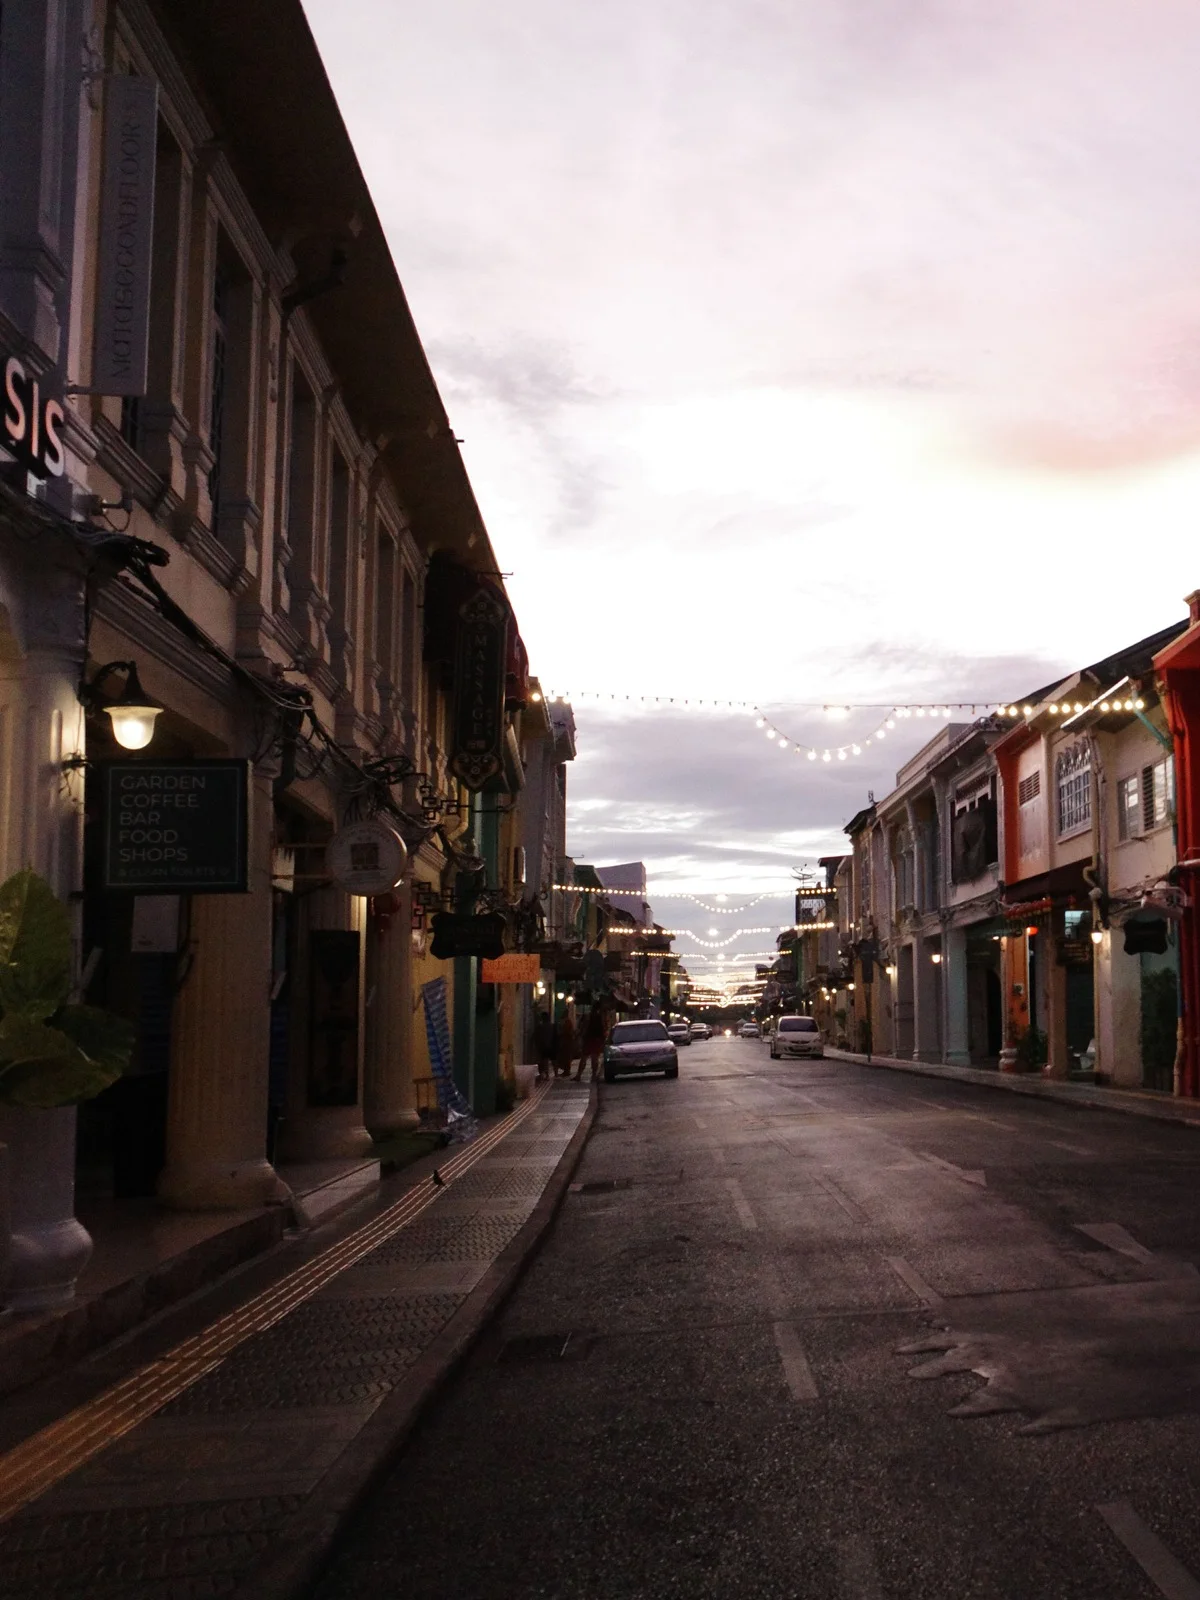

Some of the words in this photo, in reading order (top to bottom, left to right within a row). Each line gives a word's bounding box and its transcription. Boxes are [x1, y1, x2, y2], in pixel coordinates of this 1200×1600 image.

[5, 357, 65, 477] SIS
[473, 635, 487, 735] MASSAGE
[120, 775, 206, 789] GARDEN
[120, 794, 200, 808] COFFEE
[119, 812, 161, 825] BAR
[119, 830, 178, 843] FOOD
[119, 848, 188, 862] SHOPS
